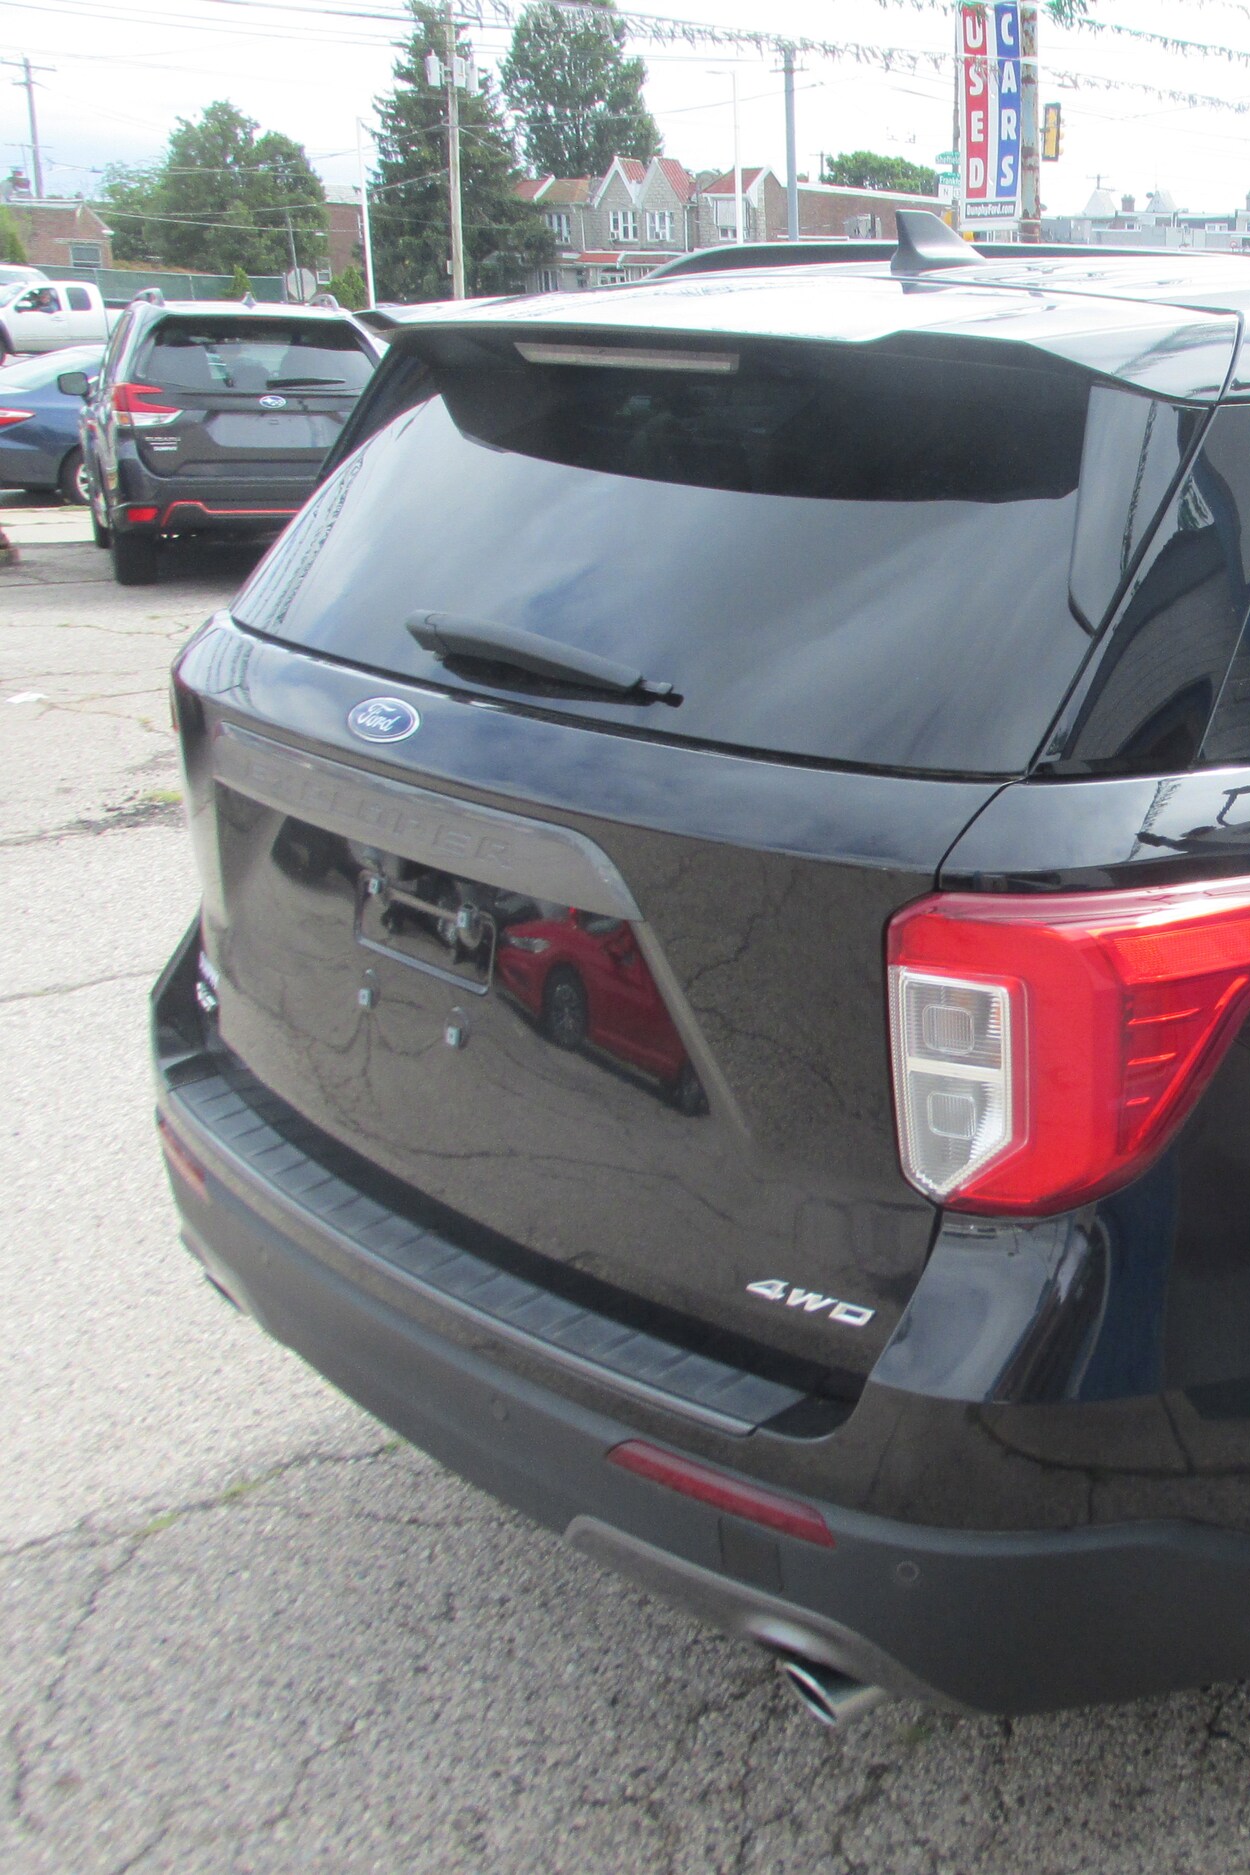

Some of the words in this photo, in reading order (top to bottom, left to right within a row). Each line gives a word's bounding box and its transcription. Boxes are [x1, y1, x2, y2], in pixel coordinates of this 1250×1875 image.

[965, 14, 985, 189] USED
[1000, 12, 1018, 188] CARS
[356, 702, 402, 732] Ford
[746, 1279, 877, 1327] 4WD
